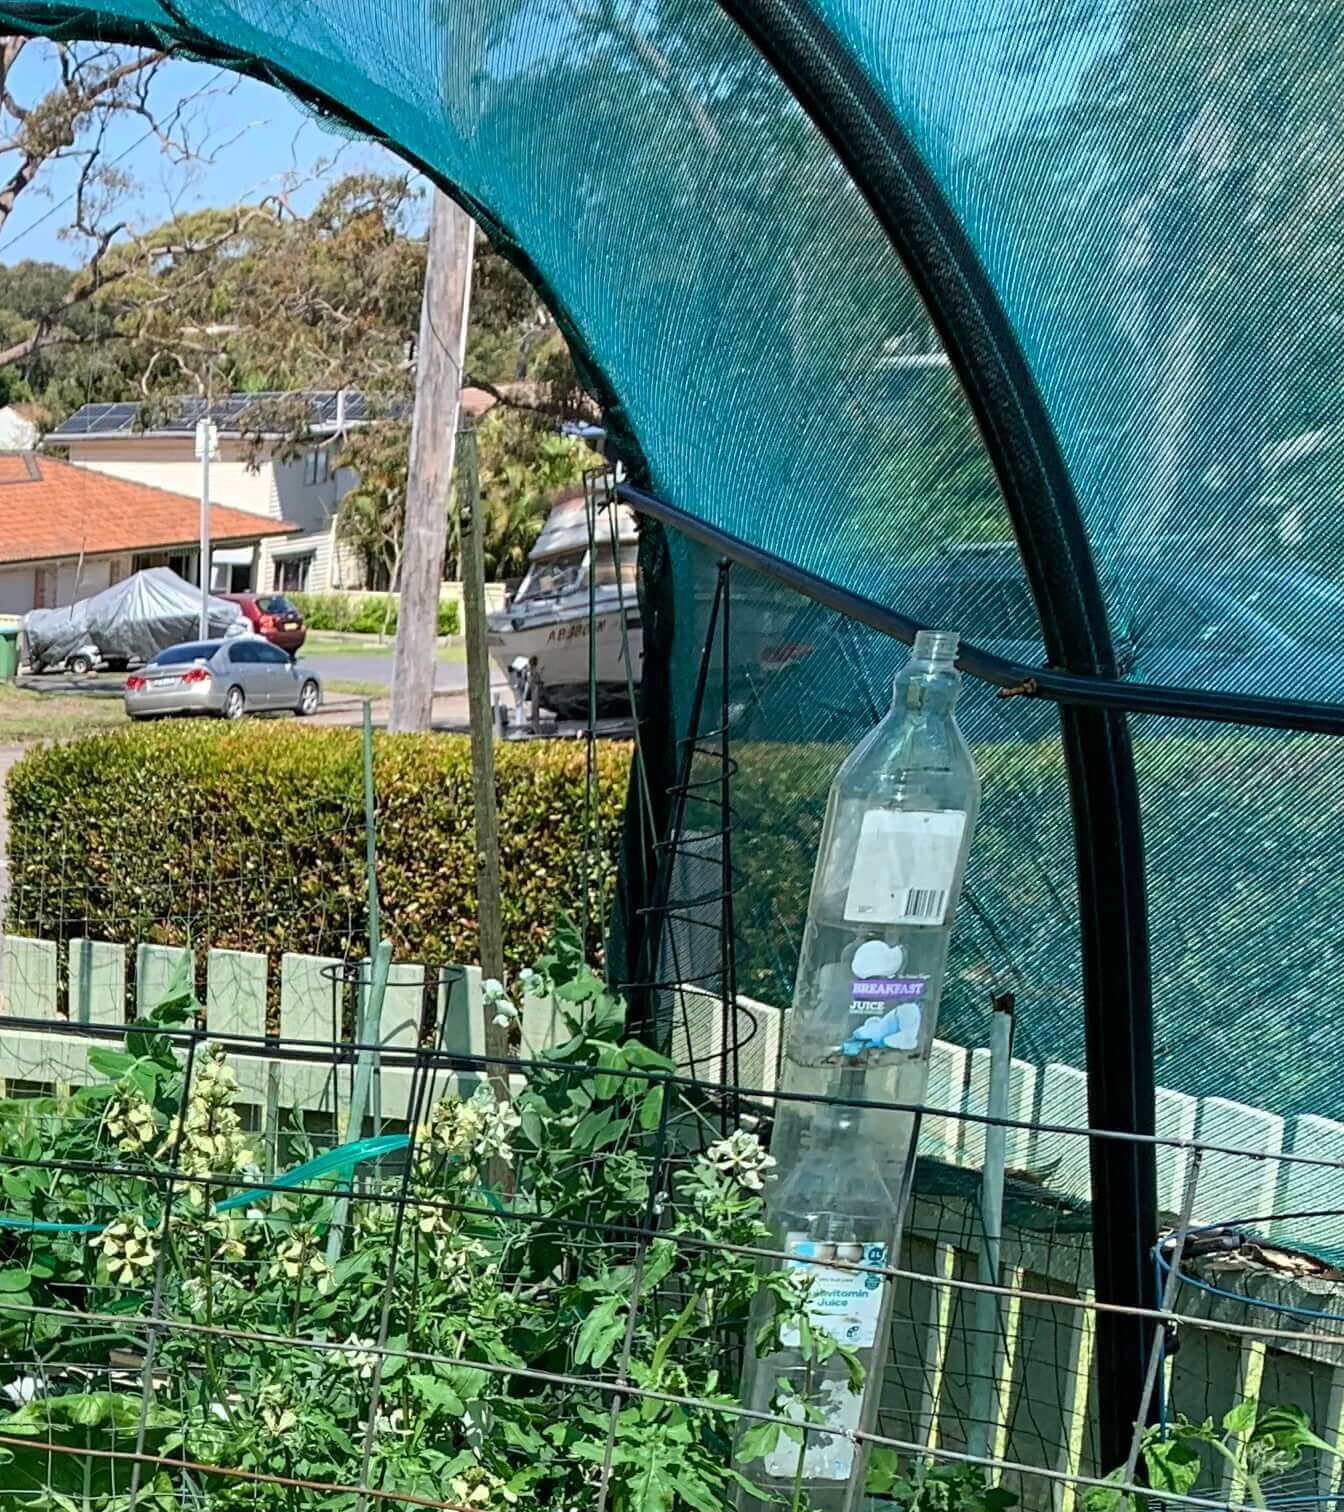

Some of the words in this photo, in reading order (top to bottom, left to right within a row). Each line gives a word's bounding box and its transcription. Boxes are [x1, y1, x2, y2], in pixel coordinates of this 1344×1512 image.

[852, 982, 924, 995] BREAKFAST
[849, 1000, 886, 1010] JUICE
[816, 1299, 849, 1307] Juice
